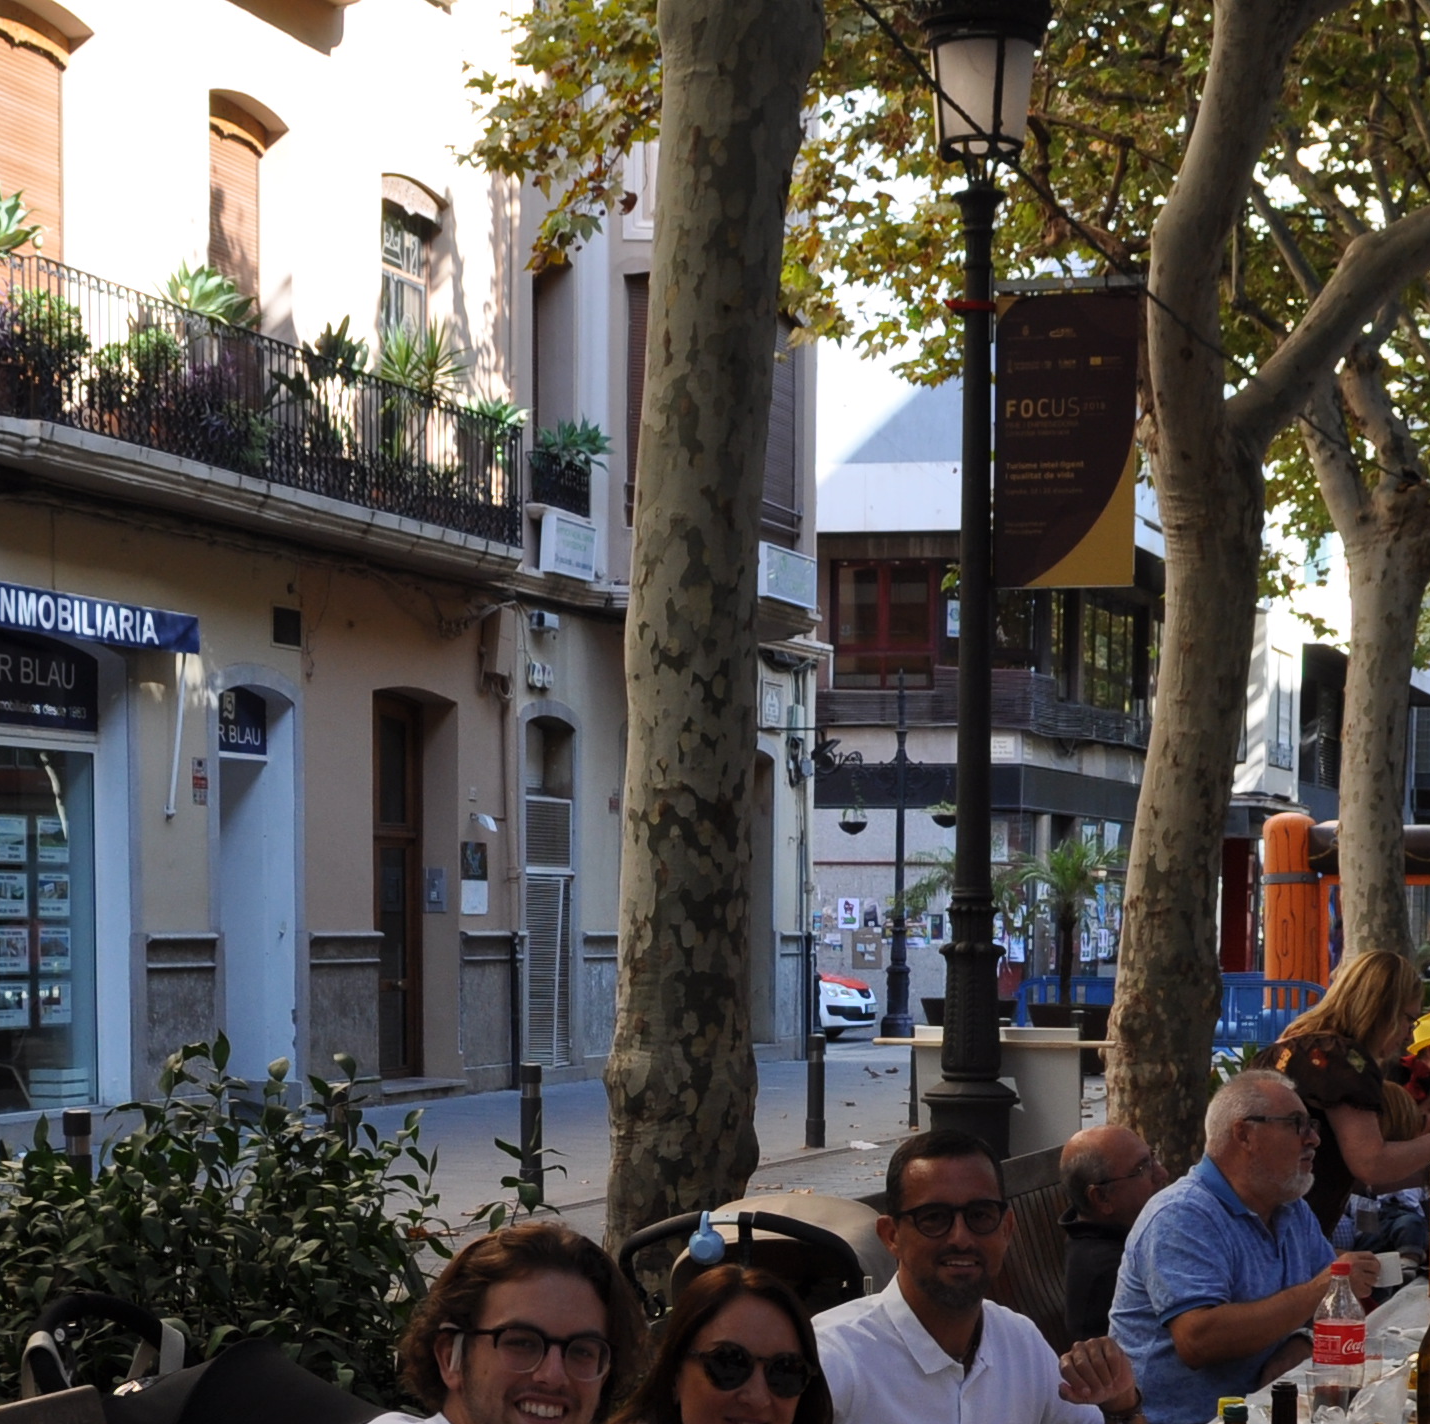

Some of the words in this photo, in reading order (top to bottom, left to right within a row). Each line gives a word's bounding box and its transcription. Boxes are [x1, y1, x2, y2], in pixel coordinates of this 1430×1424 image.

[1005, 396, 1080, 419] FOCUS
[1057, 471, 1075, 479] vida
[20, 657, 75, 691] BLAU
[228, 724, 261, 746] BLAU
